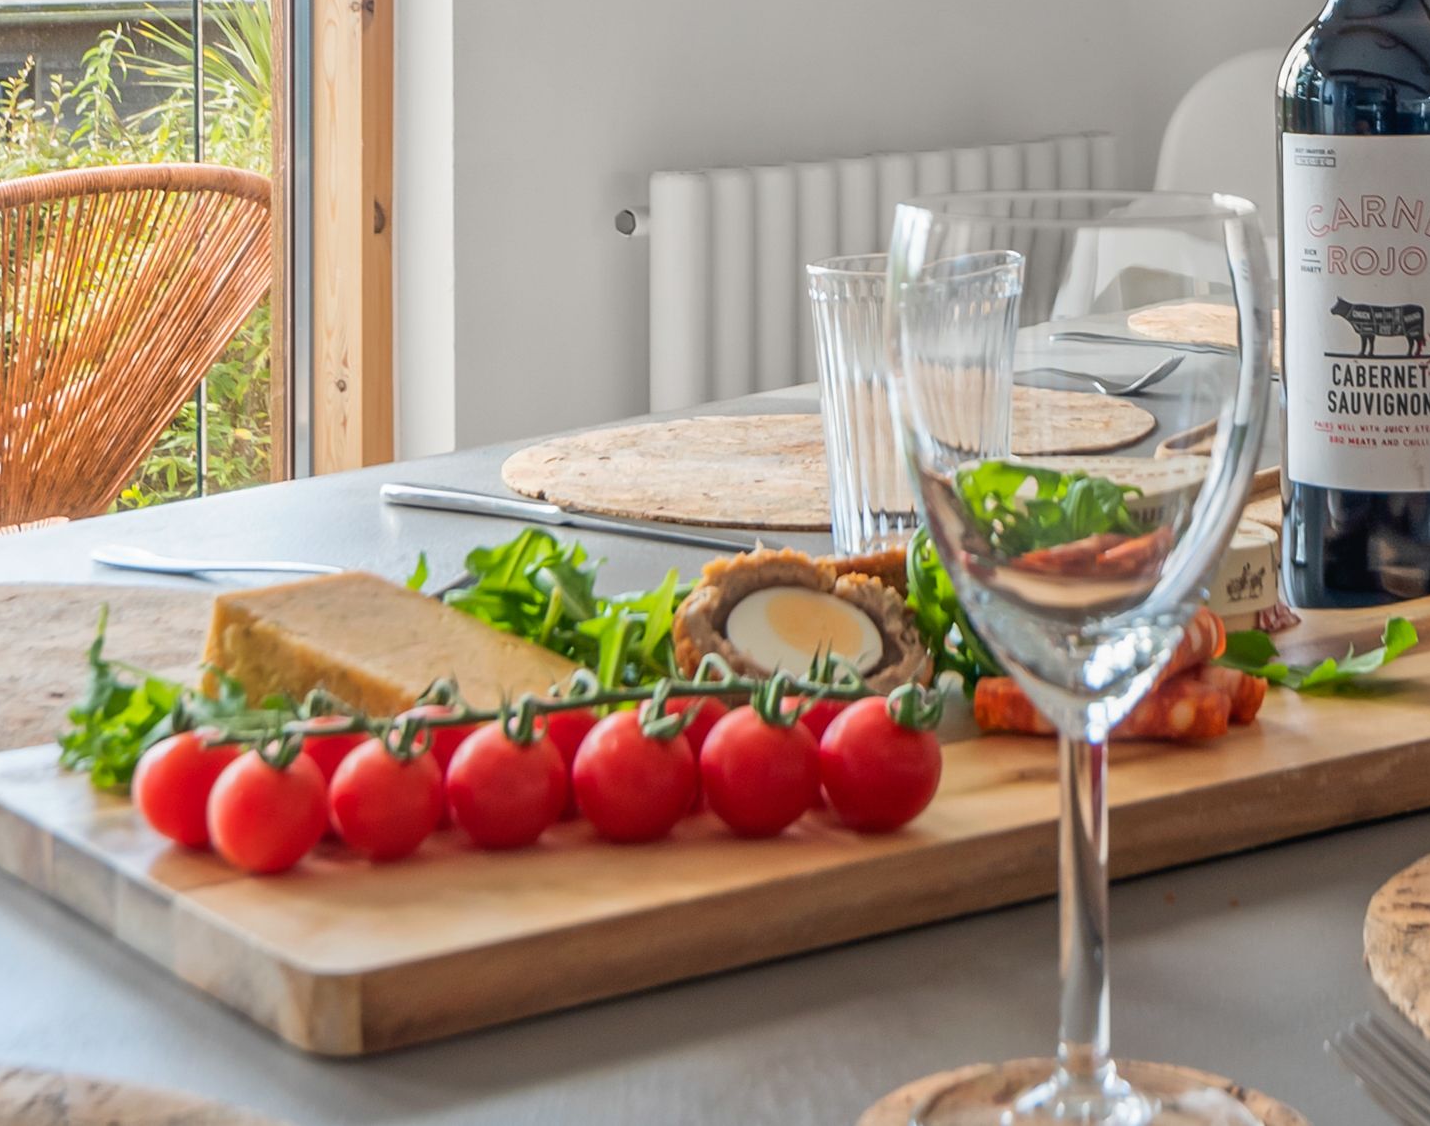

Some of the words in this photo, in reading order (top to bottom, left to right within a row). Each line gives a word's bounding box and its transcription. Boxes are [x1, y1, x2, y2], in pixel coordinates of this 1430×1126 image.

[1327, 245, 1428, 276] ROJO
[1331, 363, 1429, 389] CABERNET
[1337, 423, 1356, 432] WELL
[1360, 425, 1380, 433] WITH
[1384, 424, 1410, 434] JUICY
[1348, 436, 1378, 447] MEATS
[1381, 437, 1400, 447] AND
